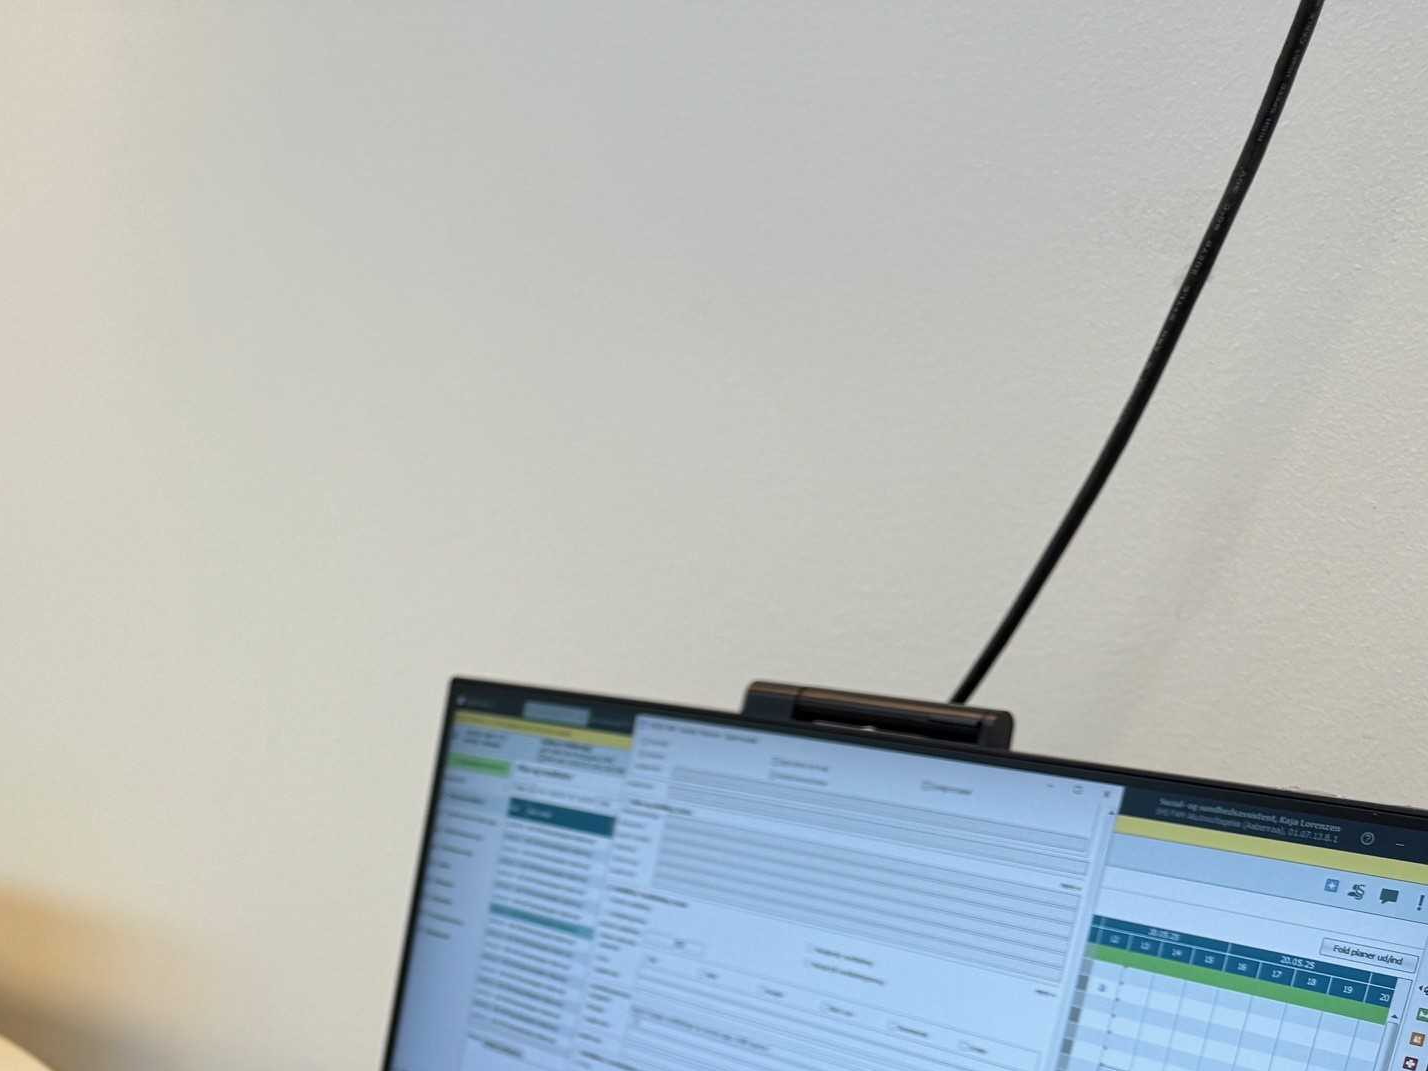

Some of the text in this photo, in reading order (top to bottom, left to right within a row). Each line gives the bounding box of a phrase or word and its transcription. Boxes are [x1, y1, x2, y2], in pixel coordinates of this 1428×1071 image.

[1300, 818, 1341, 833] Lorenzen
[1280, 955, 1316, 970] 20.05.25
[1333, 944, 1403, 966] Fold planer ud/ind
[1272, 969, 1283, 979] 17
[1343, 985, 1354, 994] 19
[1379, 993, 1390, 1002] 20
